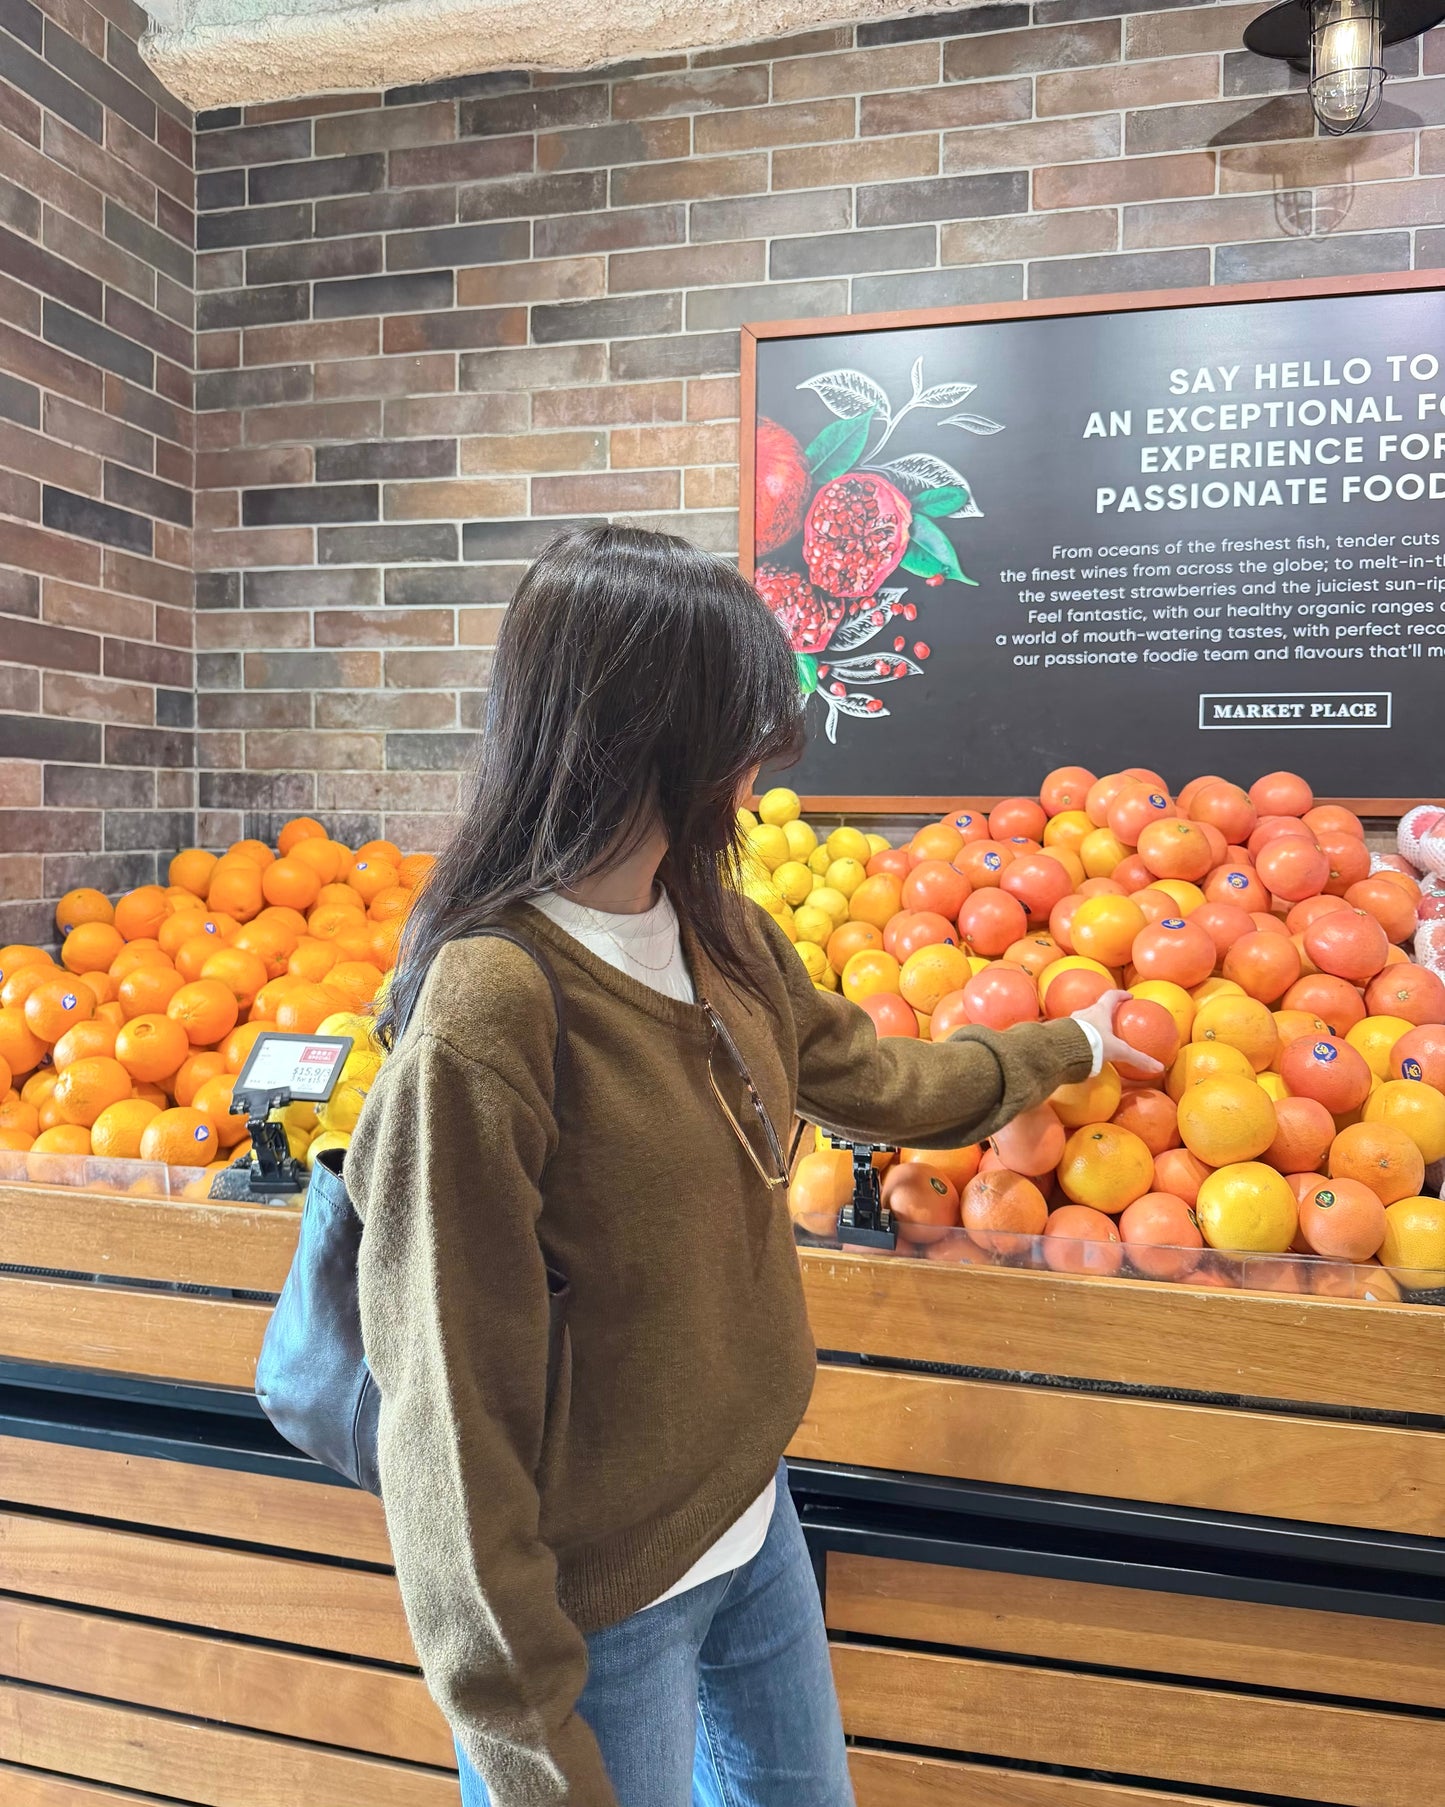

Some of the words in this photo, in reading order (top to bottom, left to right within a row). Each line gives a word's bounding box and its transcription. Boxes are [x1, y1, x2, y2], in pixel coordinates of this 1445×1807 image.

[1169, 365, 1240, 395] SAY
[1255, 357, 1372, 390] HELLO
[1386, 353, 1439, 382] TO
[1082, 410, 1132, 439] AN
[1146, 395, 1403, 435] EXCEPTIONAL
[1418, 393, 1445, 420] F
[1140, 436, 1364, 473] EXPERIENCE
[1096, 477, 1328, 514] PASSIONATE
[1342, 472, 1445, 503] FOOD
[1052, 545, 1093, 560] From
[1097, 544, 1160, 558] oceans
[1164, 540, 1183, 555] of
[1186, 539, 1216, 554] the
[1220, 537, 1291, 552] freshest
[1296, 535, 1330, 551] fish,
[1335, 533, 1396, 548] tender
[1401, 532, 1440, 546] cuts
[999, 569, 1027, 583] the
[1031, 567, 1076, 582] finest
[1080, 565, 1128, 580] wines
[1132, 563, 1171, 577] from
[1176, 562, 1234, 576] across
[1238, 559, 1268, 574] the
[1272, 557, 1329, 576] globe;
[1333, 557, 1354, 571] to
[1359, 553, 1445, 570] melt-in-t
[1017, 589, 1046, 604] the
[1049, 586, 1126, 602] sweetest
[1130, 582, 1237, 599] strawberries
[1241, 580, 1277, 595] and
[1281, 580, 1312, 594] the
[1314, 578, 1380, 597] juiciest
[1028, 608, 1063, 624] Feel
[1066, 606, 1148, 623] fantastic,
[1152, 605, 1189, 620] with
[1193, 606, 1222, 619] our
[1226, 602, 1293, 619] healthy
[1297, 600, 1366, 619] organic
[1371, 601, 1435, 617] ranges
[995, 634, 1008, 646] a
[1011, 630, 1057, 645] world
[1060, 629, 1080, 644] of
[1083, 625, 1223, 643] mouth-watering
[1226, 625, 1288, 640] tastes,
[1292, 623, 1330, 638] with
[1335, 621, 1402, 640] perfect
[1012, 654, 1041, 666] our
[1044, 650, 1139, 668] passionate
[1142, 647, 1200, 663] foodie
[1202, 648, 1250, 662] team
[1253, 645, 1290, 661] and
[1293, 645, 1364, 660] flavours
[1368, 643, 1422, 659] that'll
[1427, 646, 1445, 658] m
[1213, 703, 1305, 719] MARKET
[1310, 702, 1378, 718] PLACE
